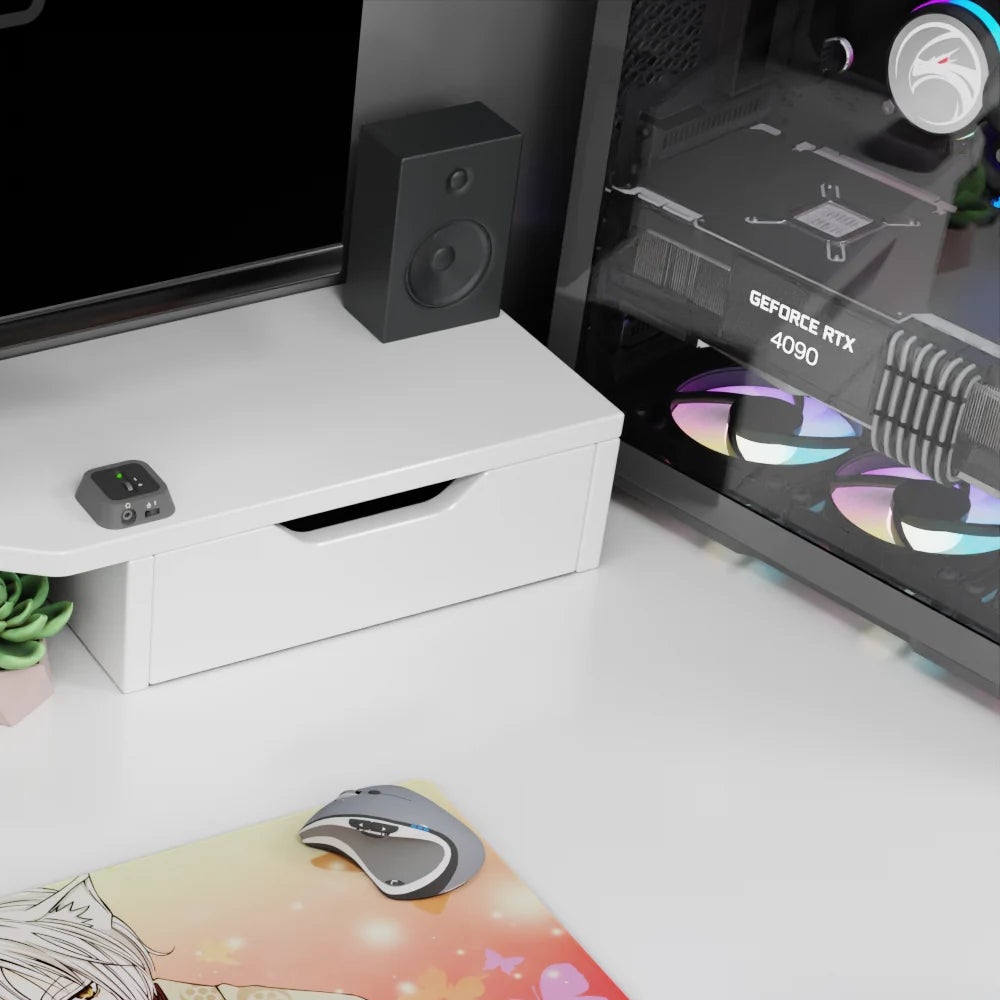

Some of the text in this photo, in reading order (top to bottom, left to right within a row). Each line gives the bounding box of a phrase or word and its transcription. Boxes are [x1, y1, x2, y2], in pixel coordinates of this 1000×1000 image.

[749, 289, 856, 353] GEFORCE RTX
[769, 331, 819, 366] 4090
